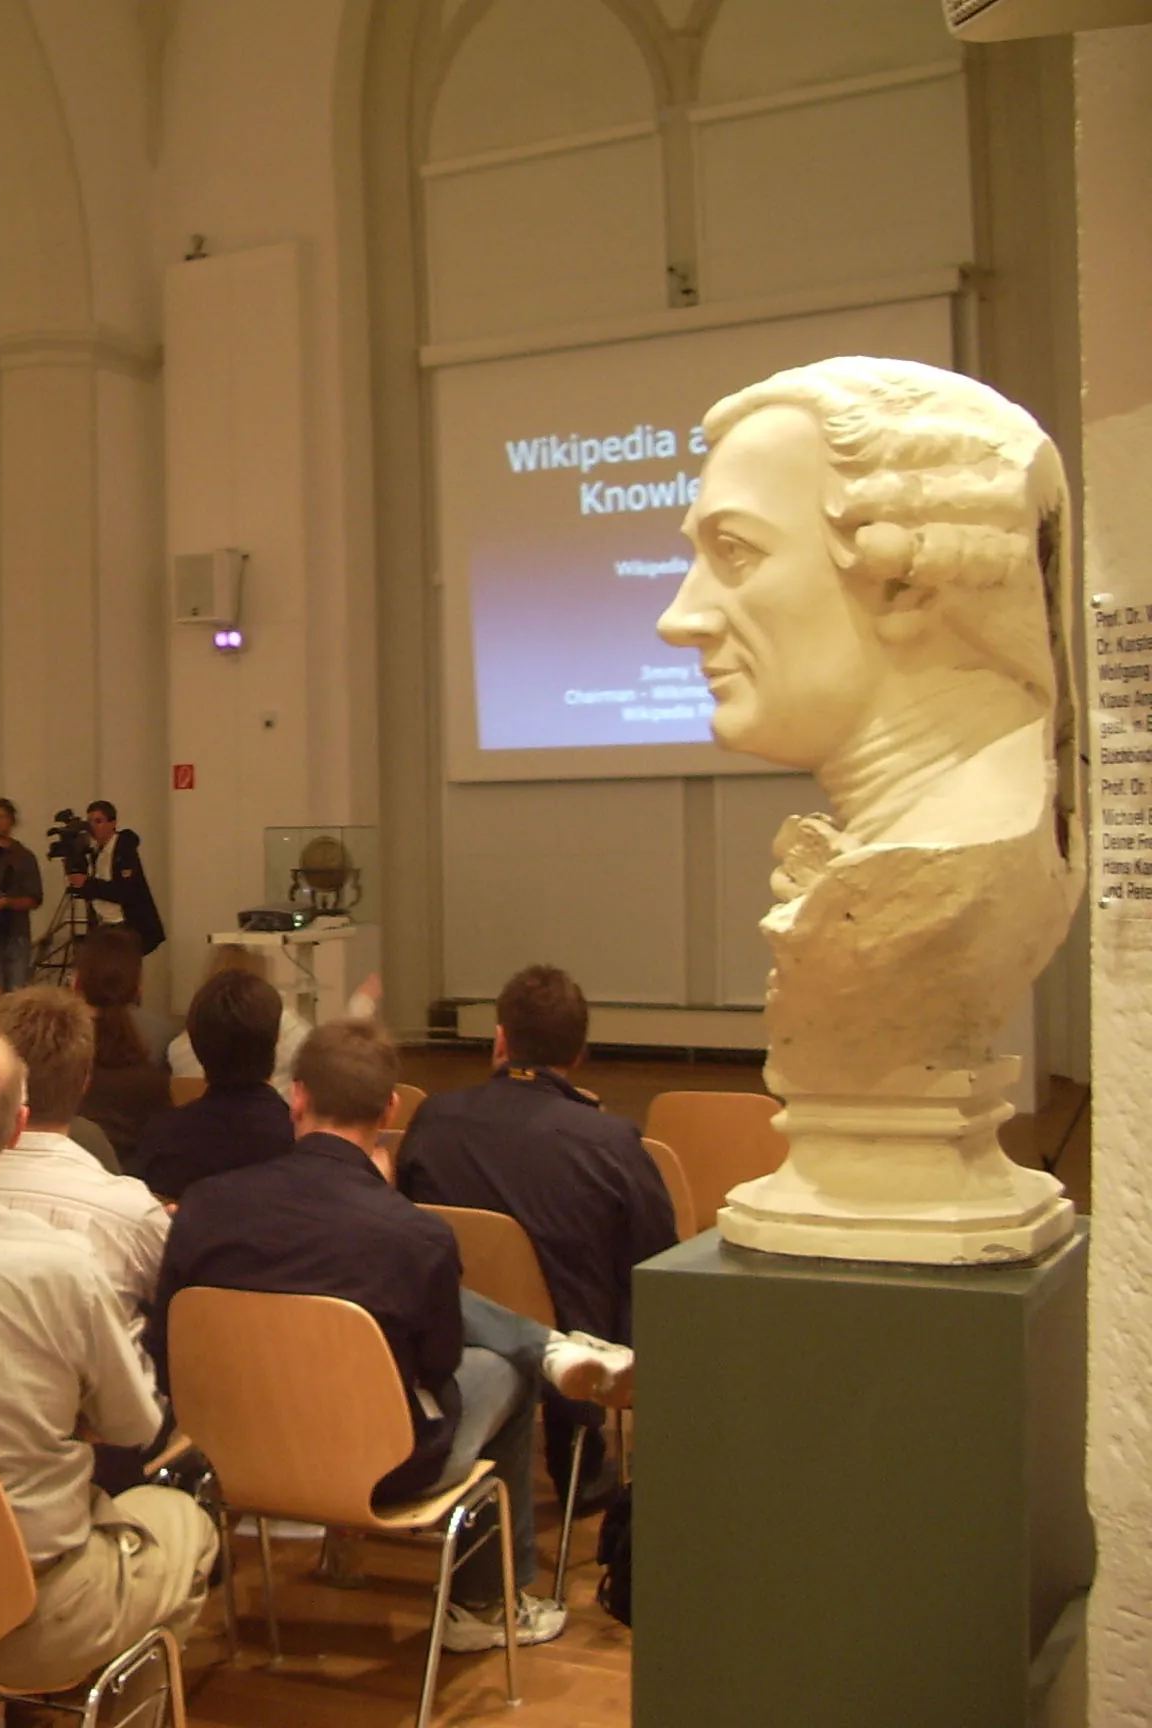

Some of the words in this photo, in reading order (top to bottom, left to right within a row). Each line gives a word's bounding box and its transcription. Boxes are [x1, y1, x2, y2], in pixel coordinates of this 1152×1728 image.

[505, 425, 676, 473] Wikipedia
[689, 427, 709, 455] a
[579, 471, 702, 516] Knowle
